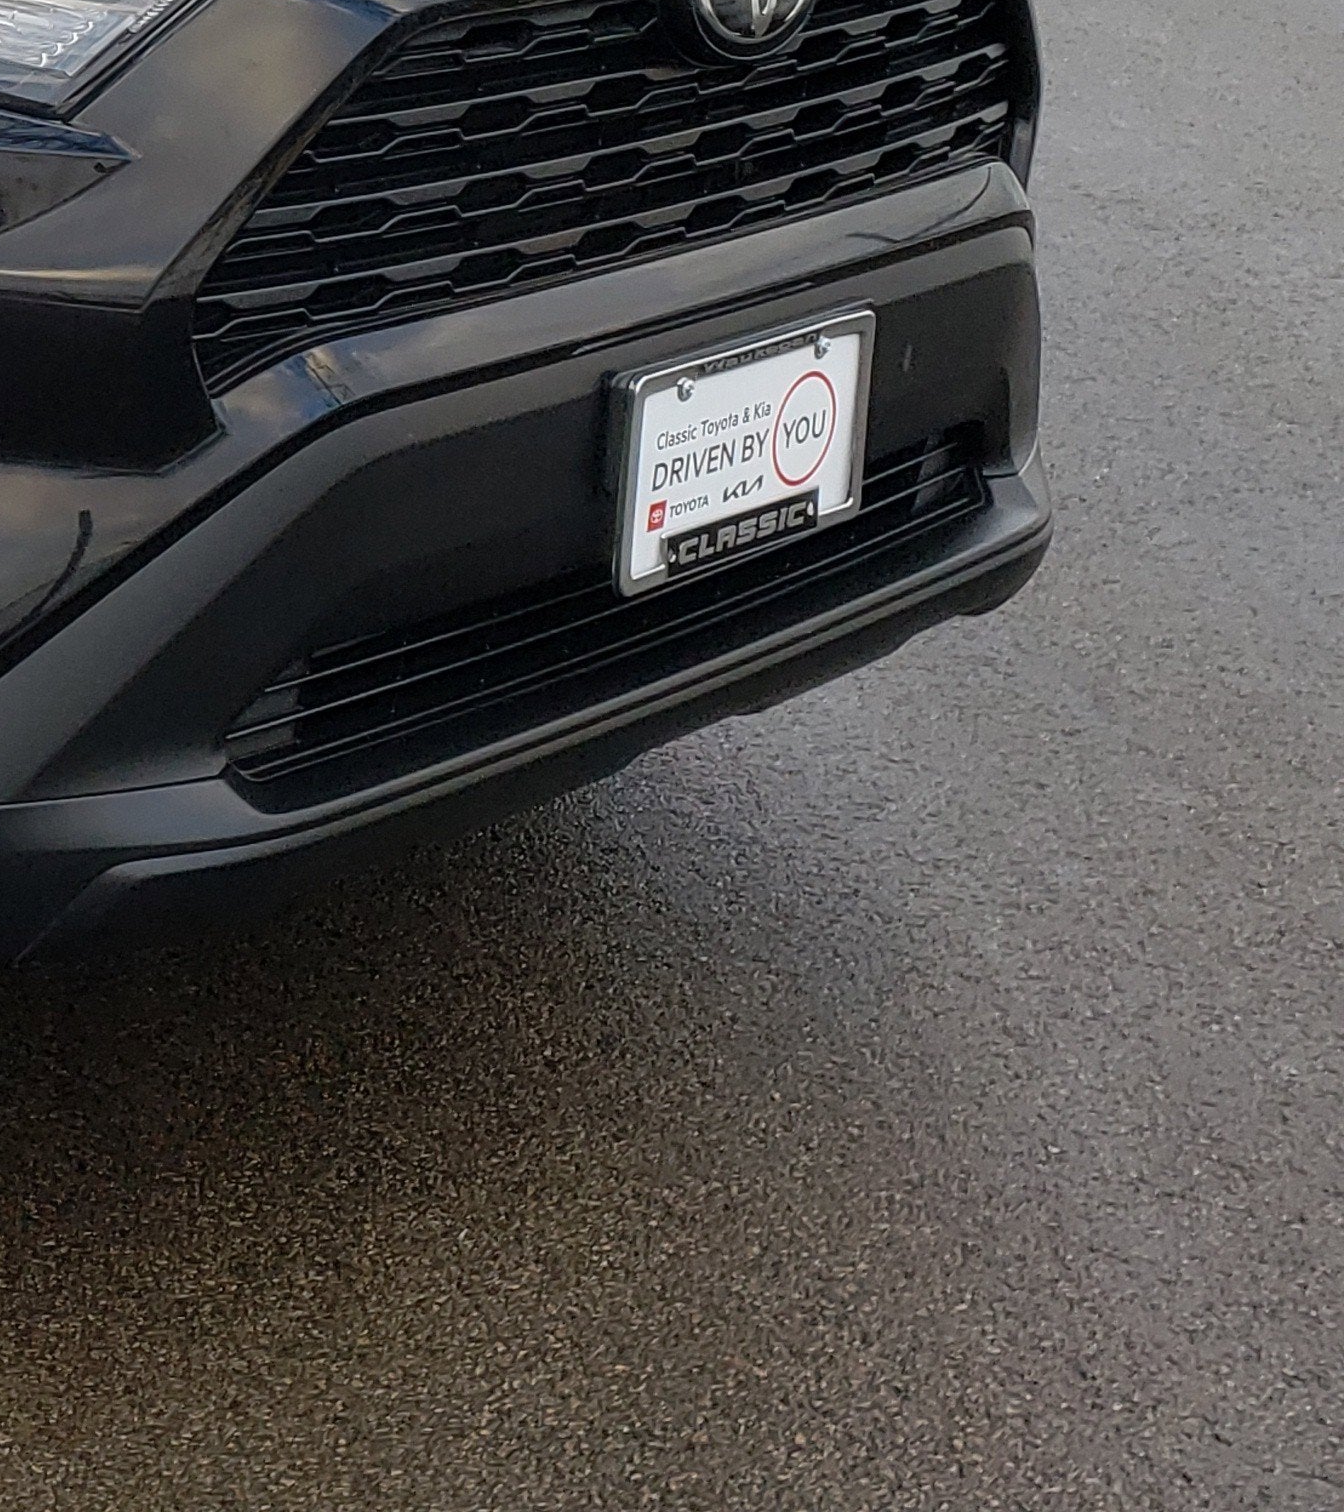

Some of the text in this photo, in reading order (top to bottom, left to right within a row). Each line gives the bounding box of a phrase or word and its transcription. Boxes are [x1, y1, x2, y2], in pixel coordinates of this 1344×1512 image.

[651, 410, 827, 491] DRIVEN BY YOU
[657, 402, 772, 451] Classic Toyota & Kia
[669, 494, 710, 518] TOYOTA
[678, 501, 807, 565] CLASSIC
